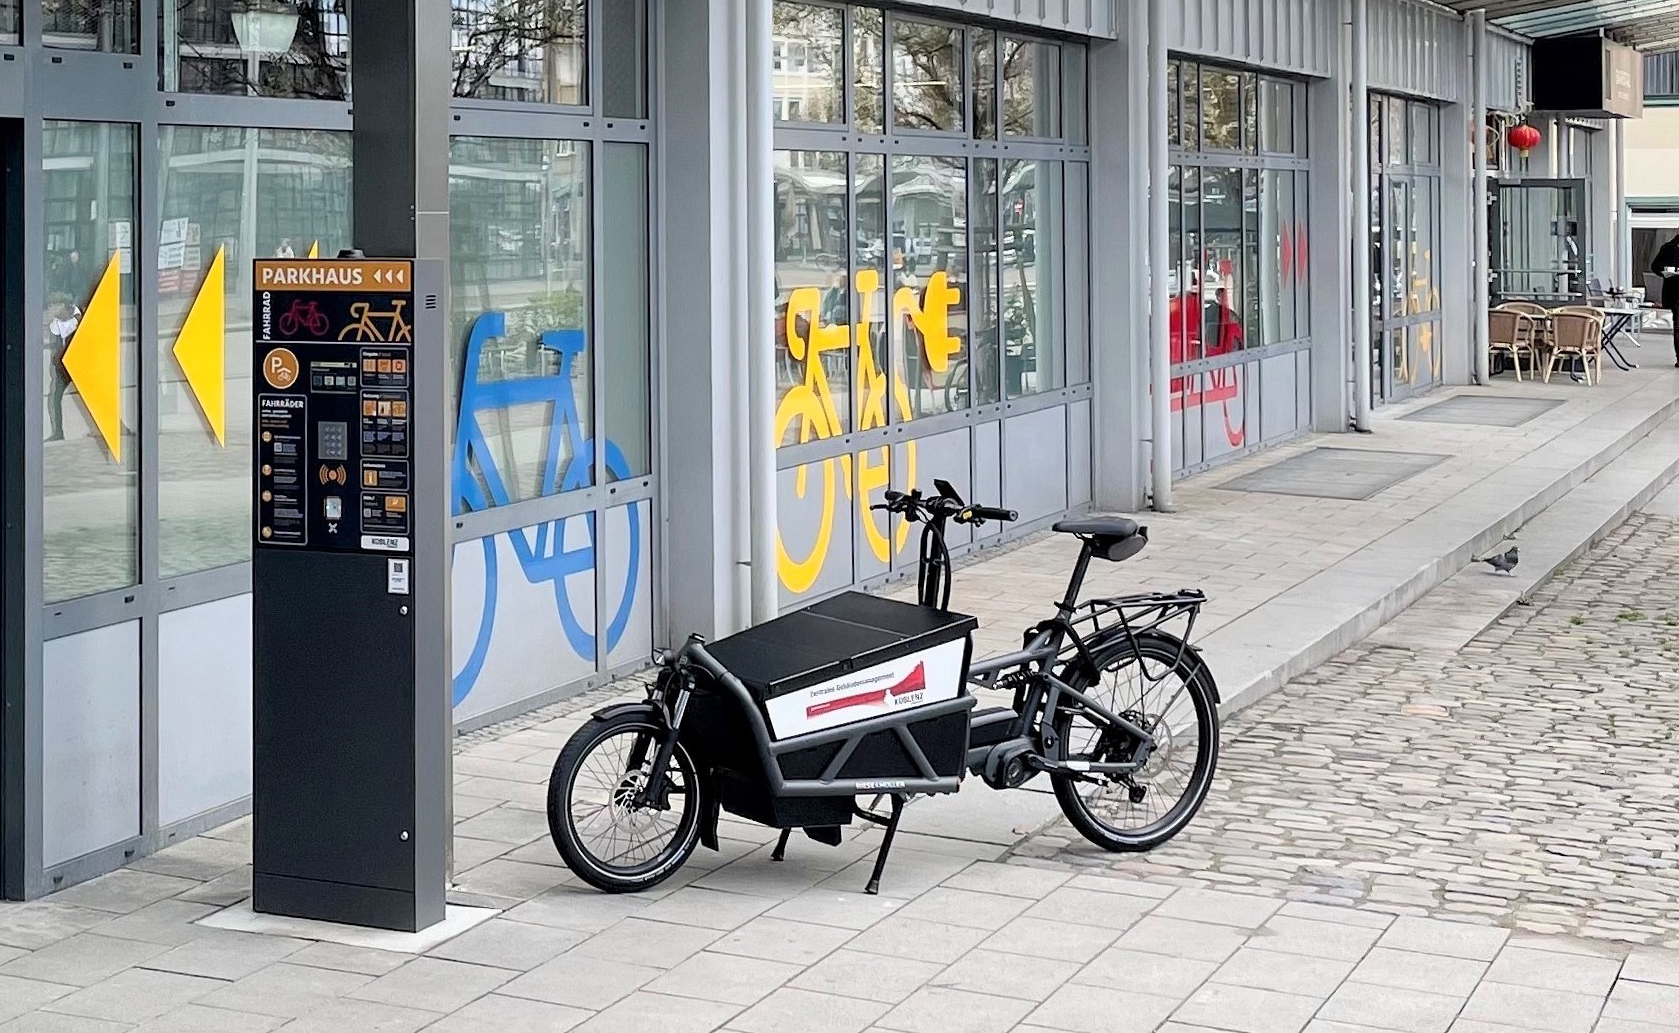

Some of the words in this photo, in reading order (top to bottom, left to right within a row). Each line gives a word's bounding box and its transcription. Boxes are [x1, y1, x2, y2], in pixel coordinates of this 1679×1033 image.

[262, 267, 363, 285] PARKHAUS
[262, 291, 271, 340] FAHRRAD
[271, 356, 282, 374] P
[261, 398, 304, 408] FAHRRÄDER
